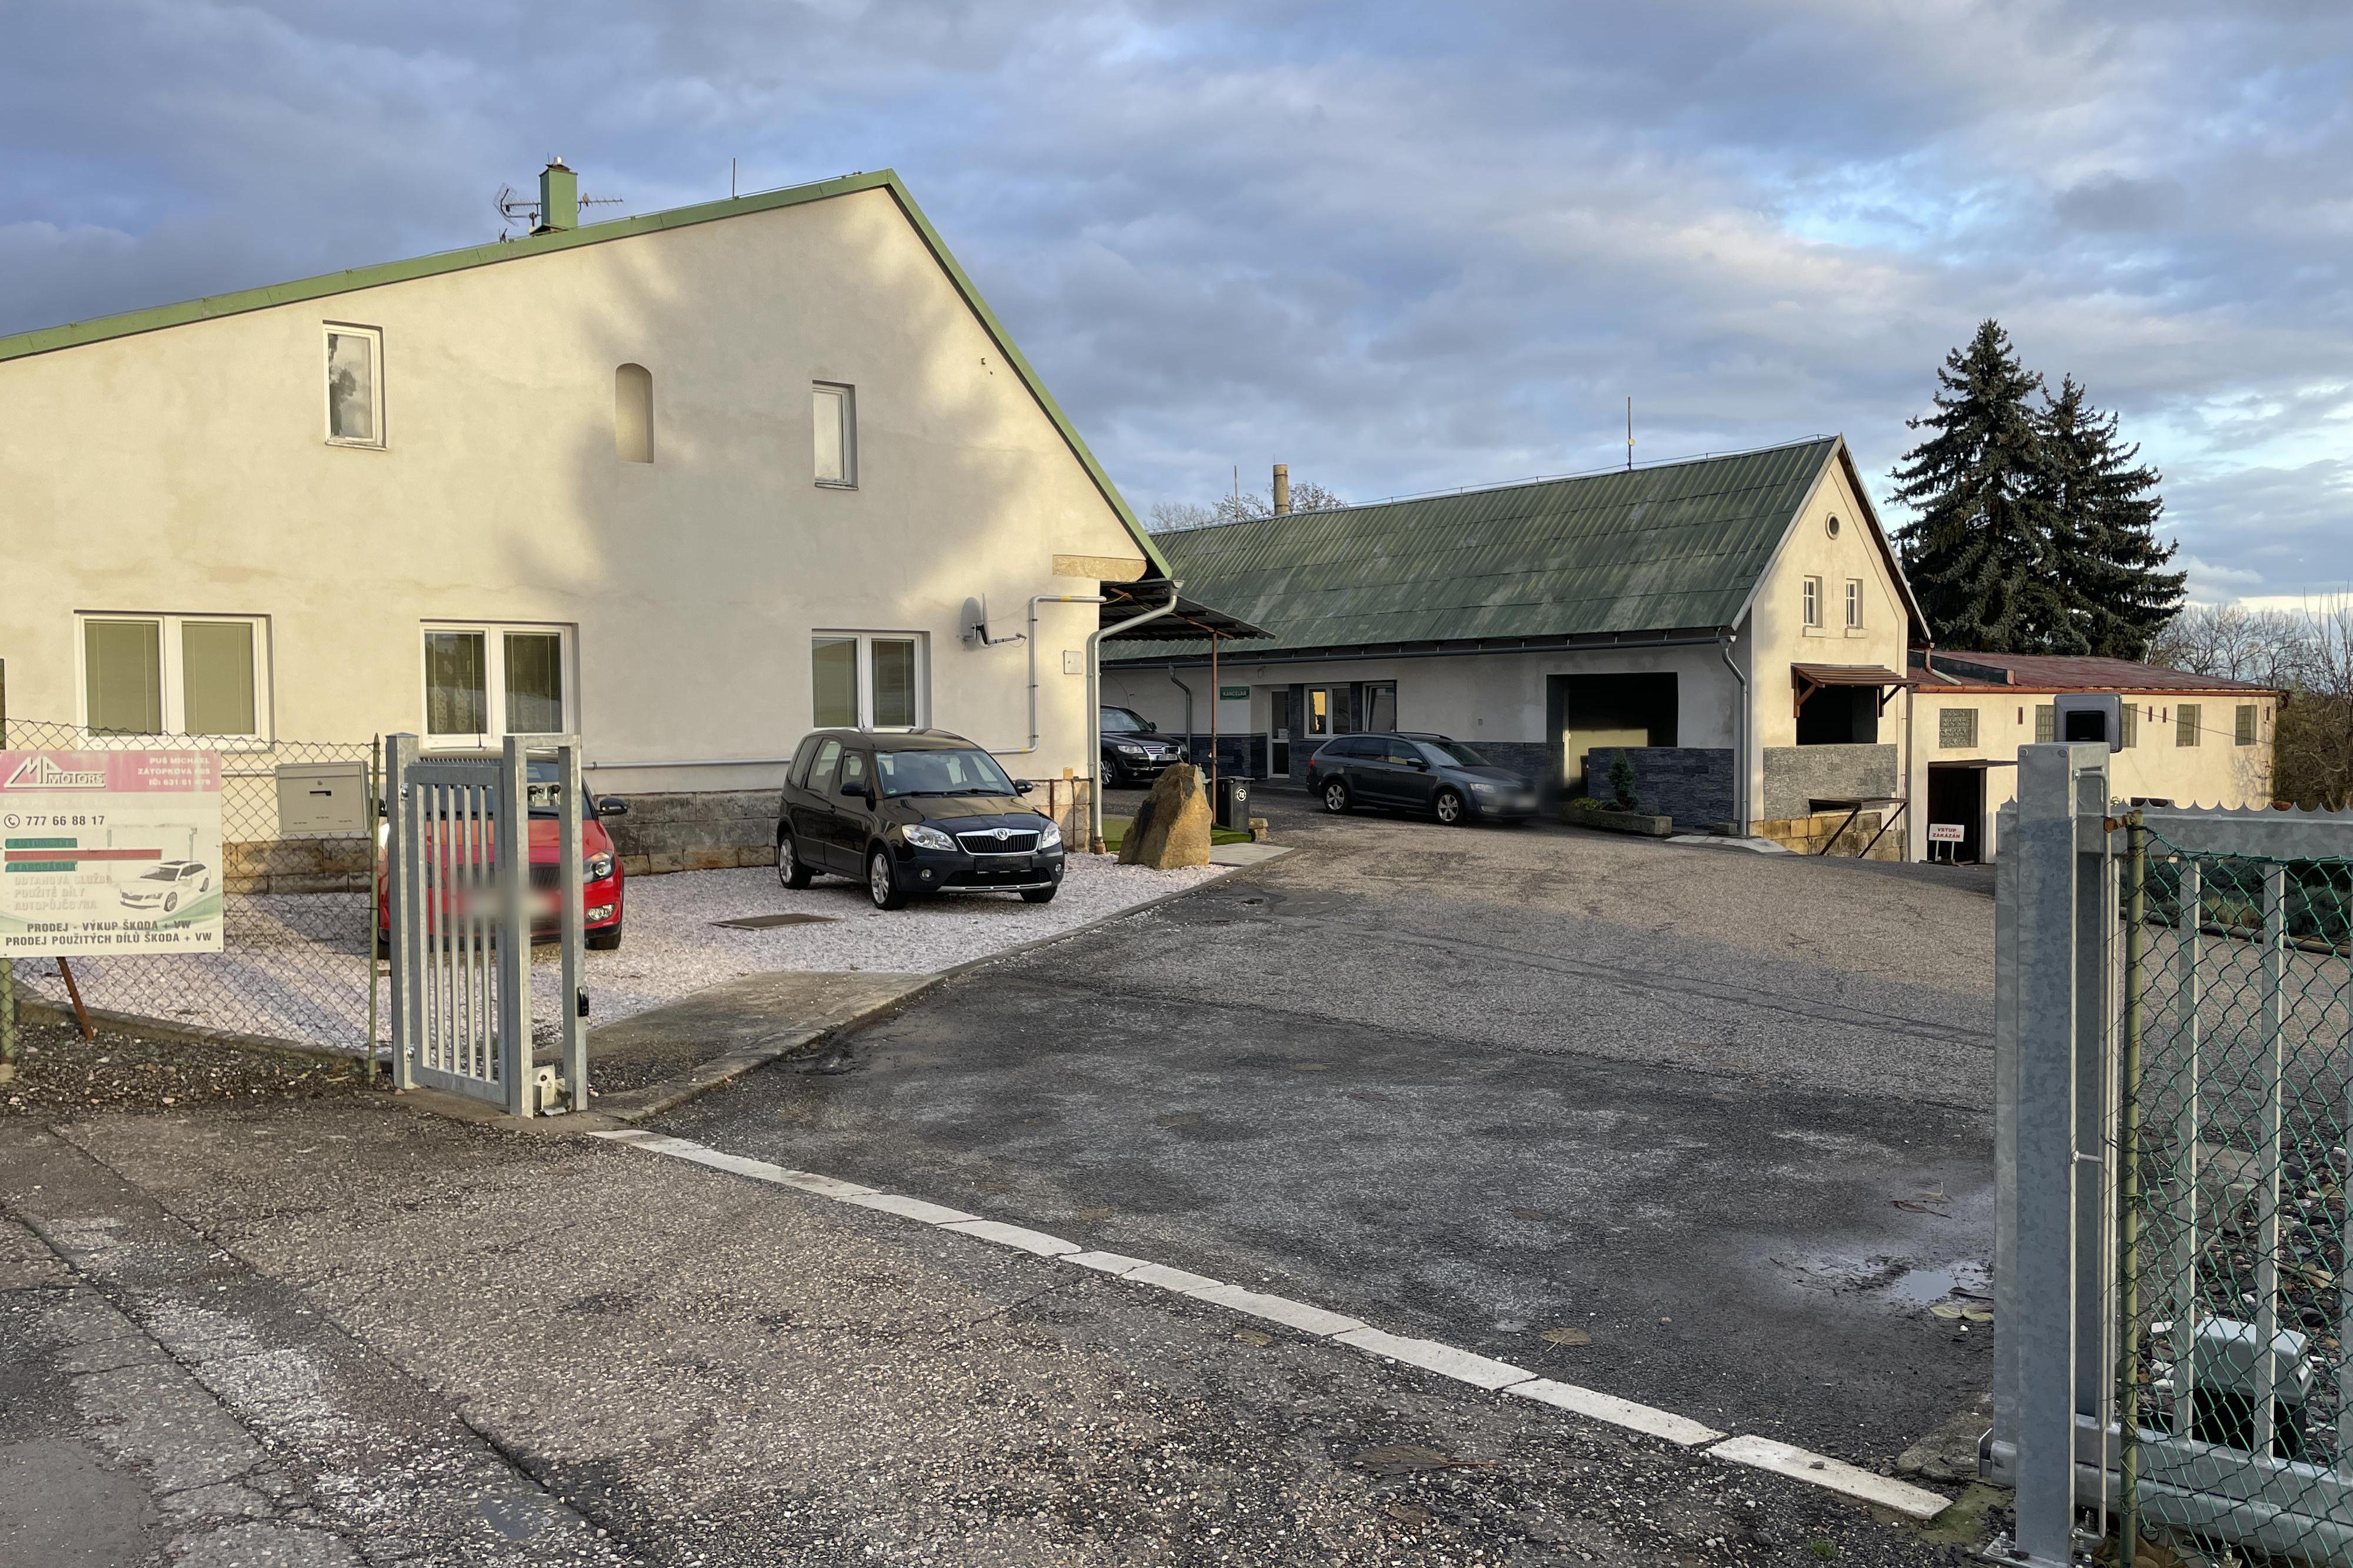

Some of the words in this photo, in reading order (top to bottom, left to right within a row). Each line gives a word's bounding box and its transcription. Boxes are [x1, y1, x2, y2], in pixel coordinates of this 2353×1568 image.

[26, 816, 46, 826] 777
[52, 816, 66, 826] 66
[72, 816, 86, 825] 88
[92, 815, 105, 825] 17
[27, 923, 68, 932] PRODEJ
[82, 919, 118, 931] VÝKUP
[123, 919, 158, 931] ŠKODA
[174, 920, 191, 929] VW
[6, 936, 47, 946] PRODEJ
[52, 933, 111, 945] POUŽITÝCH
[144, 932, 179, 943] ŠKODA
[195, 932, 212, 942] VW
